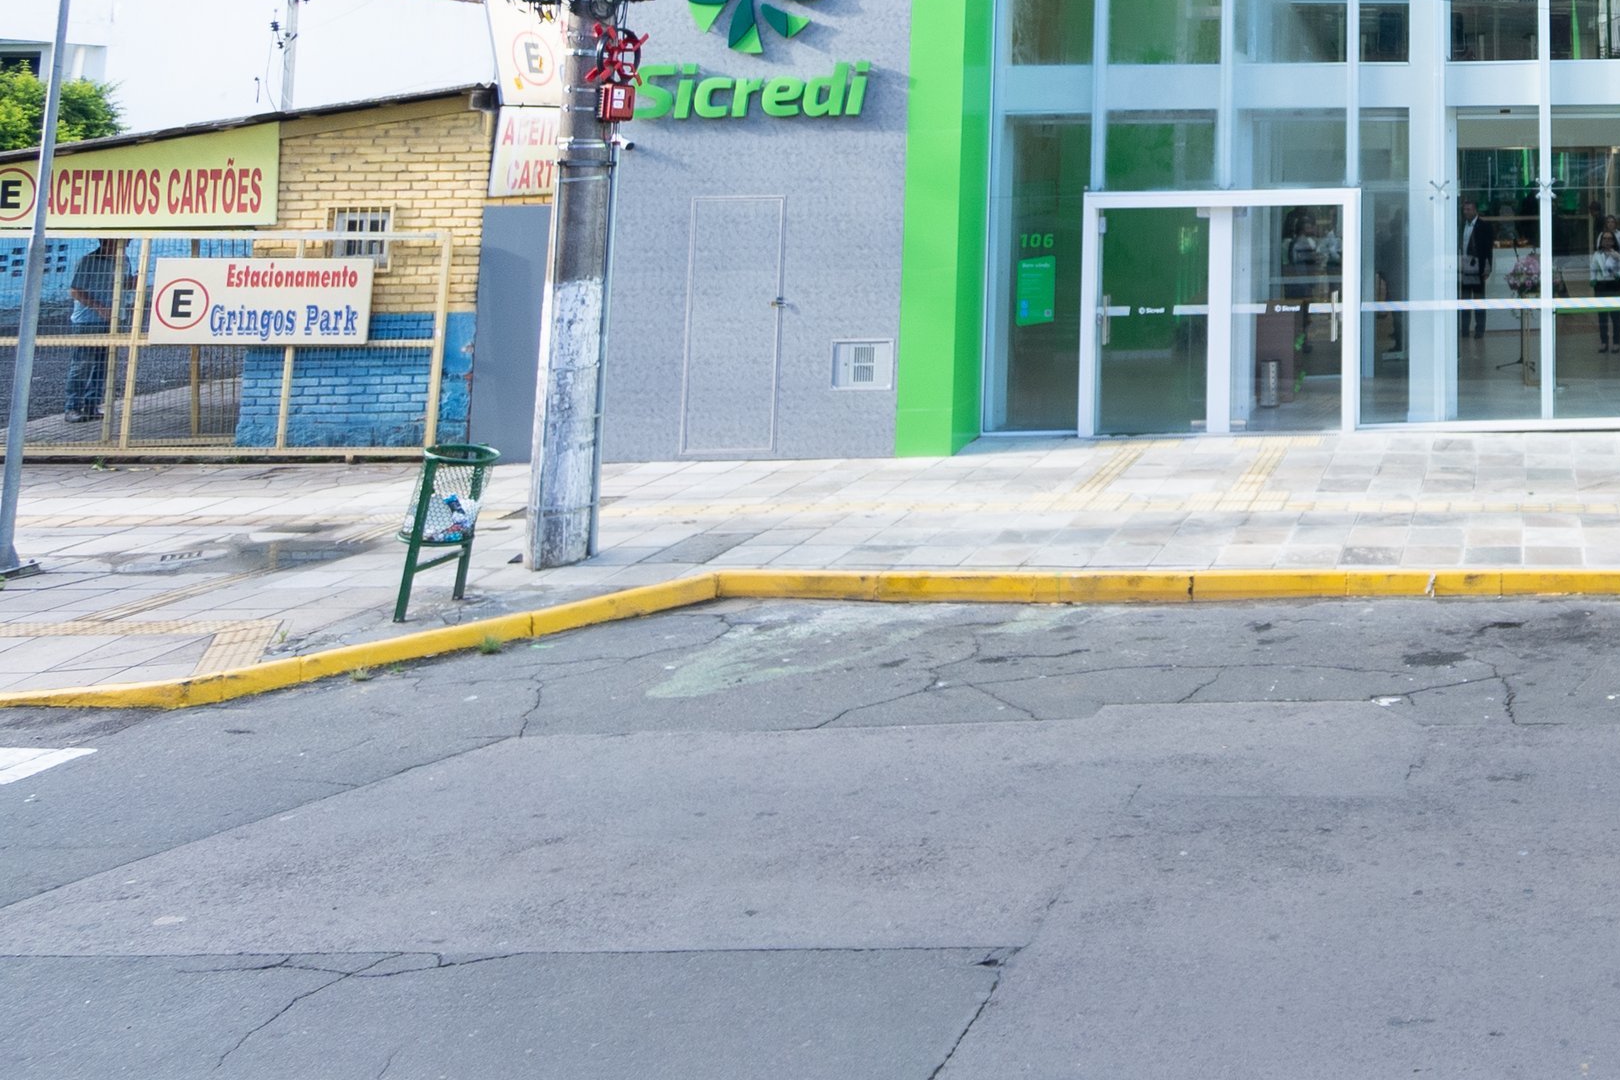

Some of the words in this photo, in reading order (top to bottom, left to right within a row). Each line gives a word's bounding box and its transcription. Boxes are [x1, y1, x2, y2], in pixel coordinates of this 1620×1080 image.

[632, 60, 872, 120] Sicredi
[1, 180, 22, 209] E
[167, 157, 262, 215] CARTÕES
[1021, 233, 1054, 249] 106
[226, 262, 358, 288] Estacionamento
[170, 289, 194, 318] E
[210, 304, 296, 341] Gringos
[304, 304, 358, 336] Park
